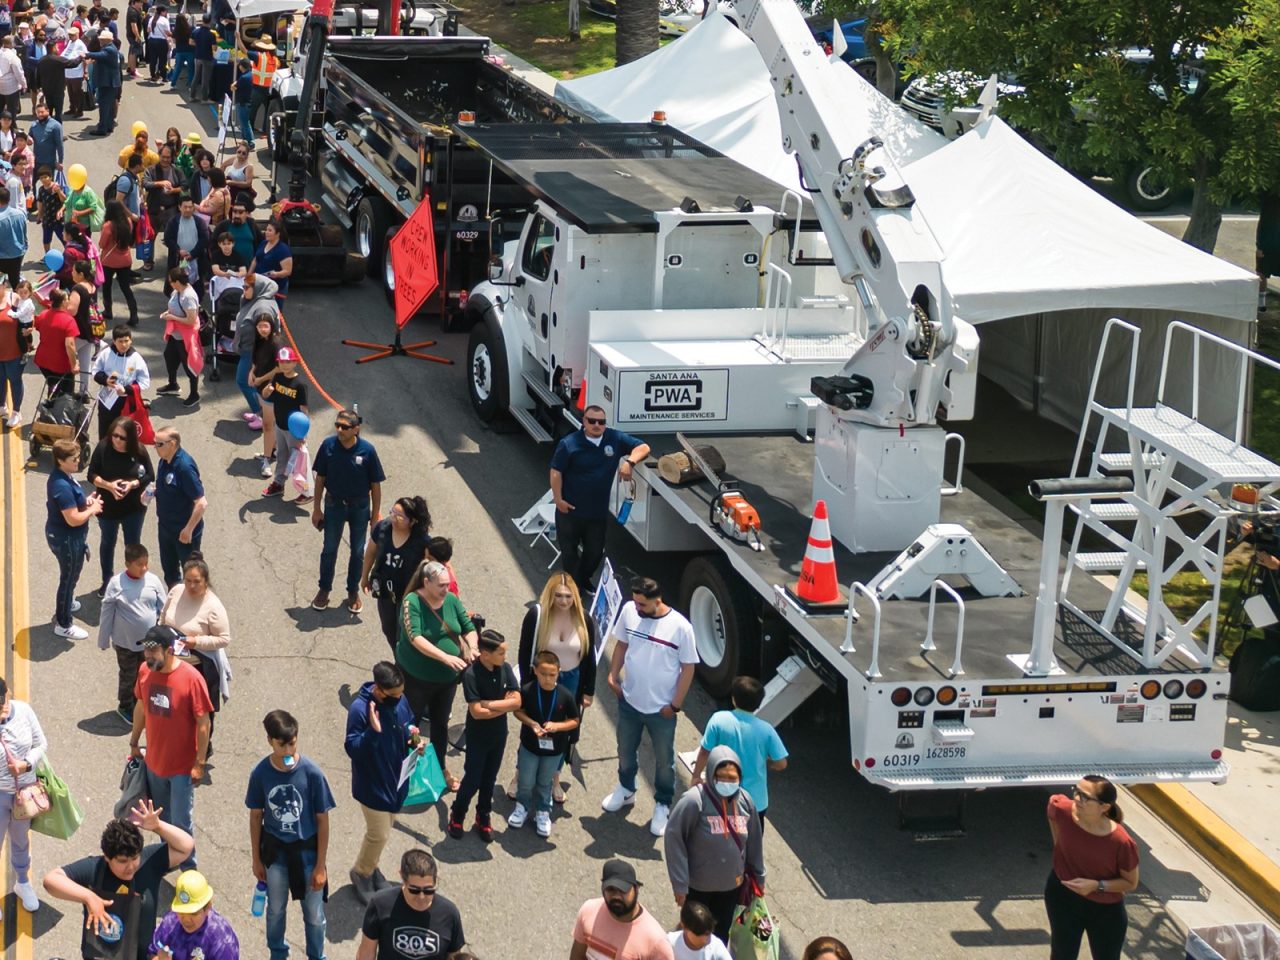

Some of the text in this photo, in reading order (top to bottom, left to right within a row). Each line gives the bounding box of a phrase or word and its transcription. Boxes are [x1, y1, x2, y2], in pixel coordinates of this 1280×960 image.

[456, 230, 479, 239] 60329
[401, 236, 429, 271] WORKING
[406, 261, 415, 280] IN
[398, 275, 416, 305] TREES
[680, 372, 699, 380] ANA
[654, 387, 692, 403] PWA
[883, 754, 920, 767] 60319
[926, 747, 966, 759] 1628598
[396, 933, 437, 953] 805
